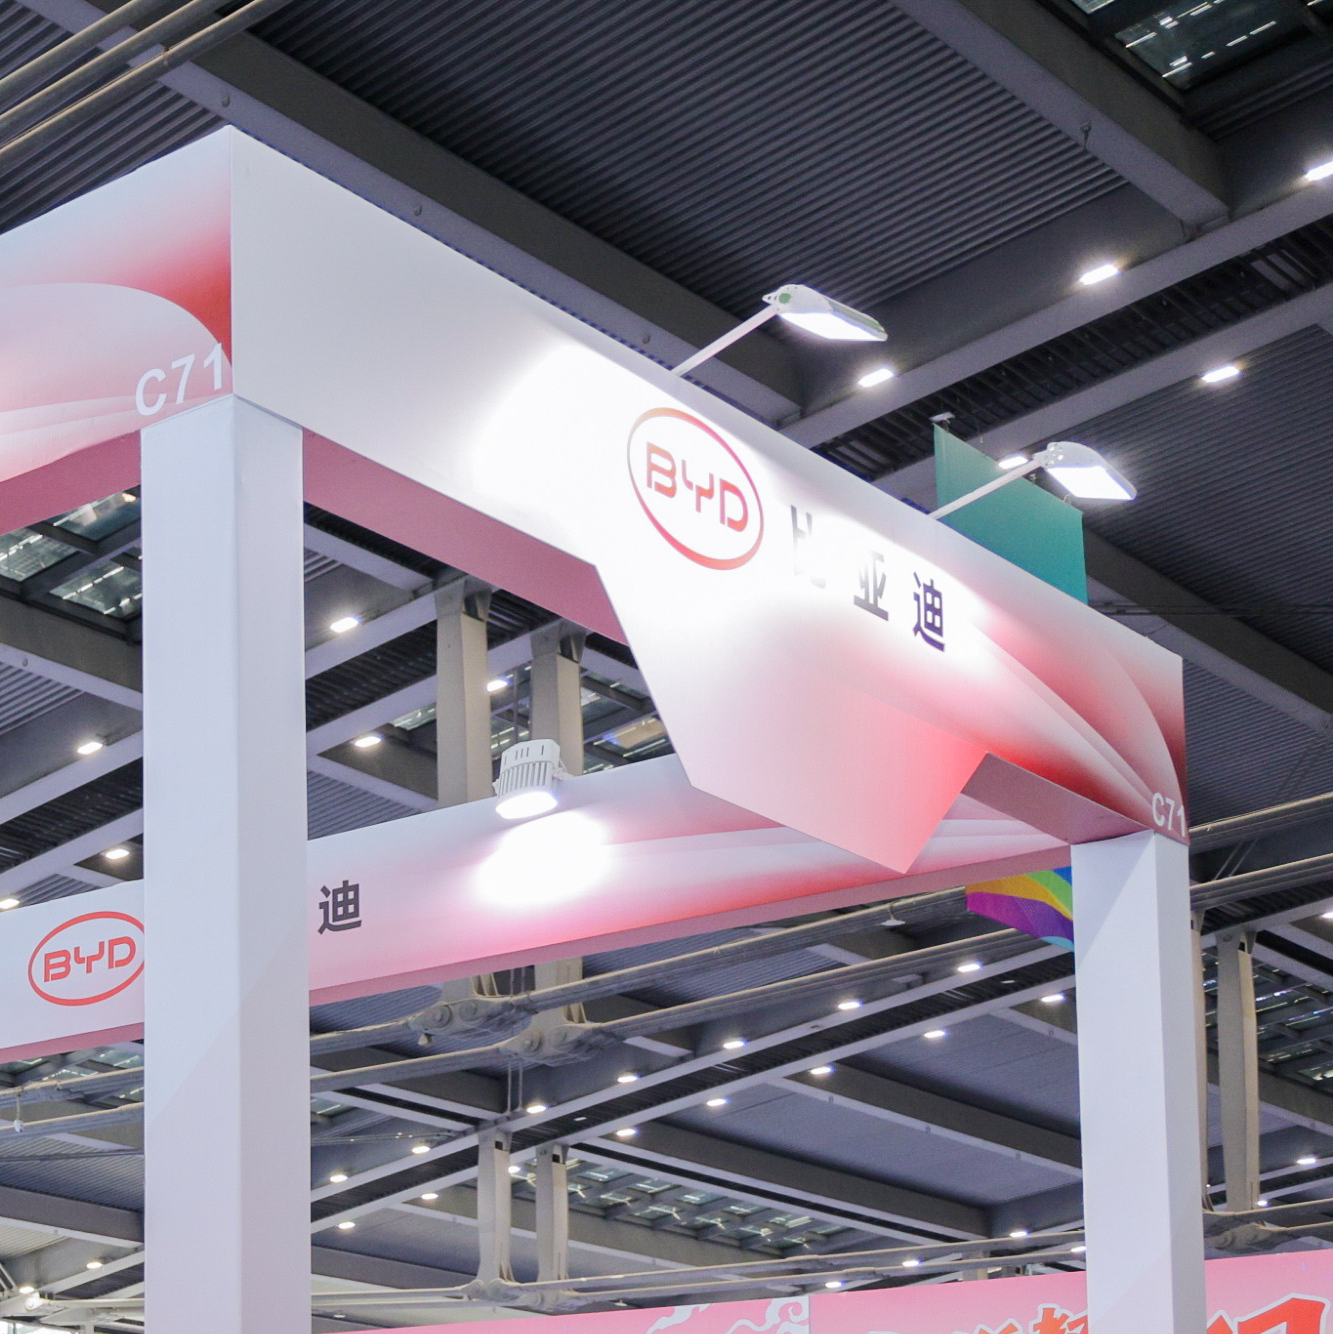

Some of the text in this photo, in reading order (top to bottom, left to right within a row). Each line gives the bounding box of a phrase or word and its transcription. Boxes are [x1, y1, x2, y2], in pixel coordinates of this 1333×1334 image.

[136, 342, 229, 420] C71
[646, 441, 749, 533] BYD
[1152, 791, 1186, 837] C71
[43, 879, 362, 982] BYD 迪
